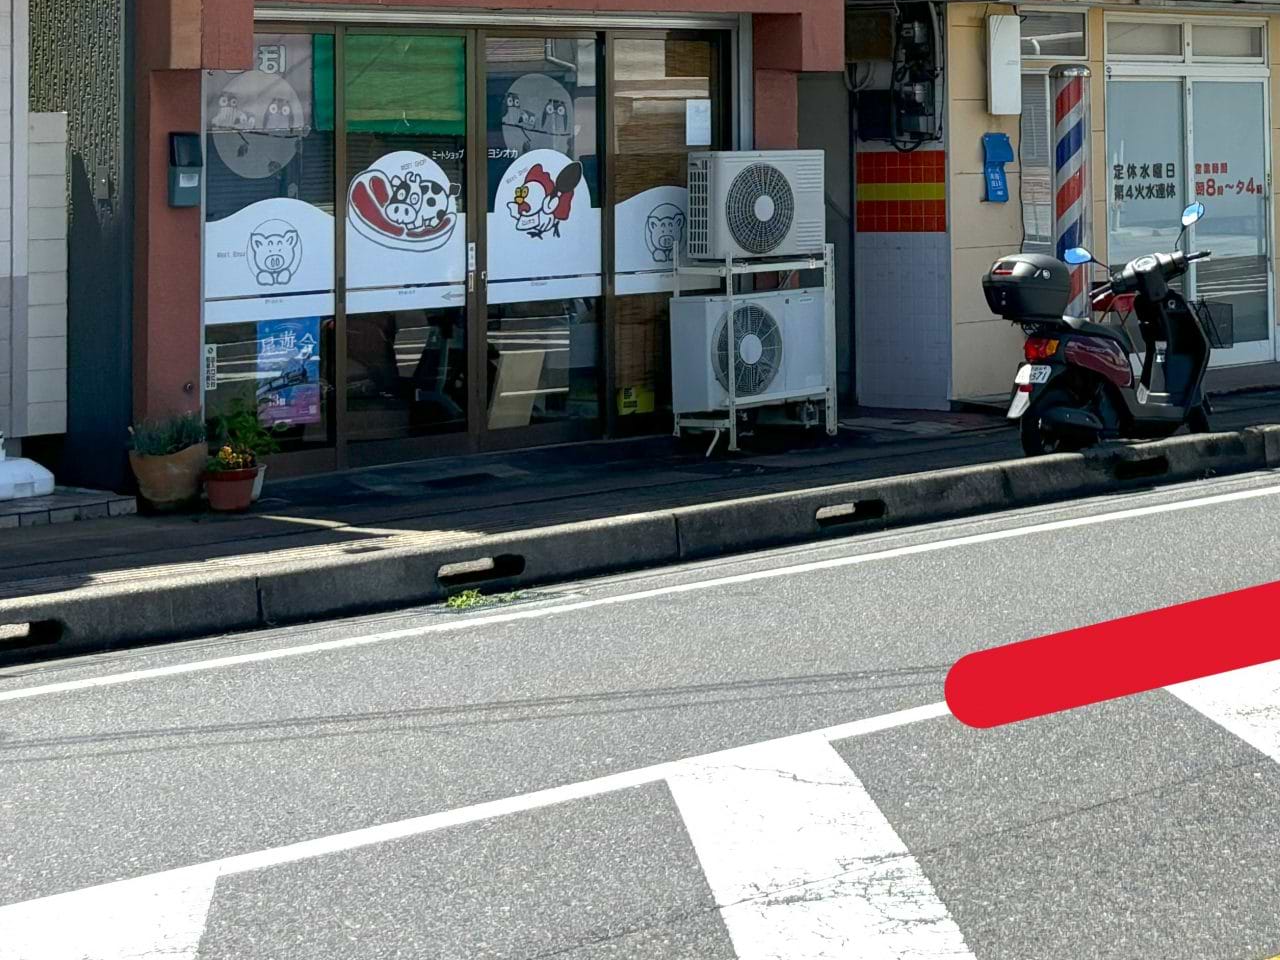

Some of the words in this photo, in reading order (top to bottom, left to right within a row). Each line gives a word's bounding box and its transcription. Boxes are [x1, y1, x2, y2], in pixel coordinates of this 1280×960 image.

[432, 150, 465, 160] ミートショップ
[487, 148, 519, 159] ヨシオカ
[1113, 163, 1176, 180] 定休水曜日
